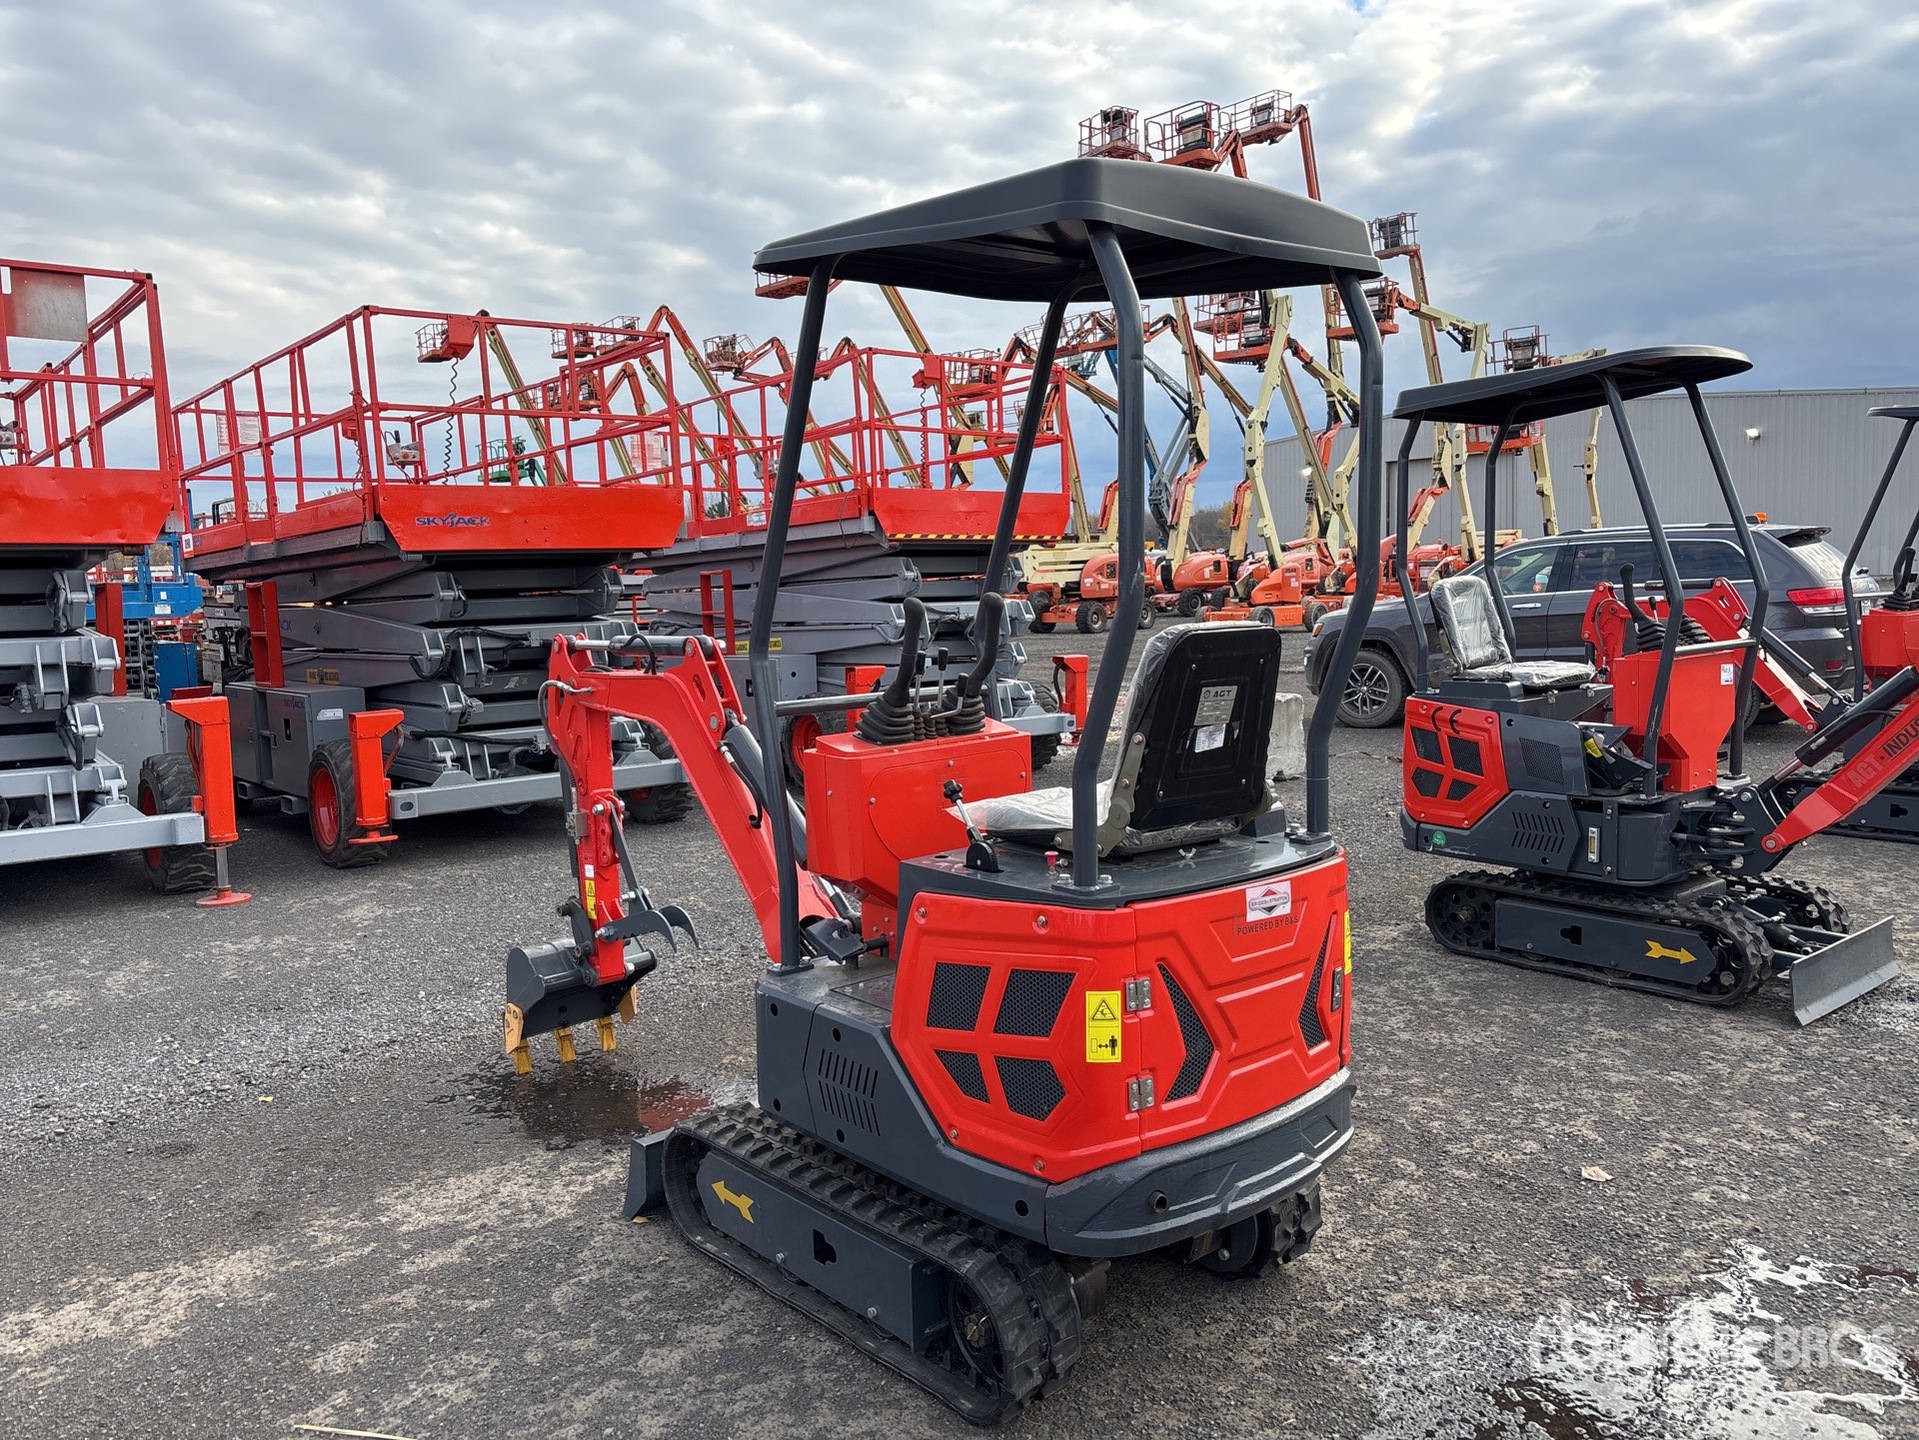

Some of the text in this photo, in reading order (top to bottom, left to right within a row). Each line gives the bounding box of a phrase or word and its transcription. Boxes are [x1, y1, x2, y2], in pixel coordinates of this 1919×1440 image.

[416, 512, 490, 528] SKYJACK
[1213, 690, 1232, 698] AGT
[1431, 706, 1462, 735] CE
[1847, 753, 1885, 790] AGT
[1236, 914, 1299, 936] POWERED BY B&S
